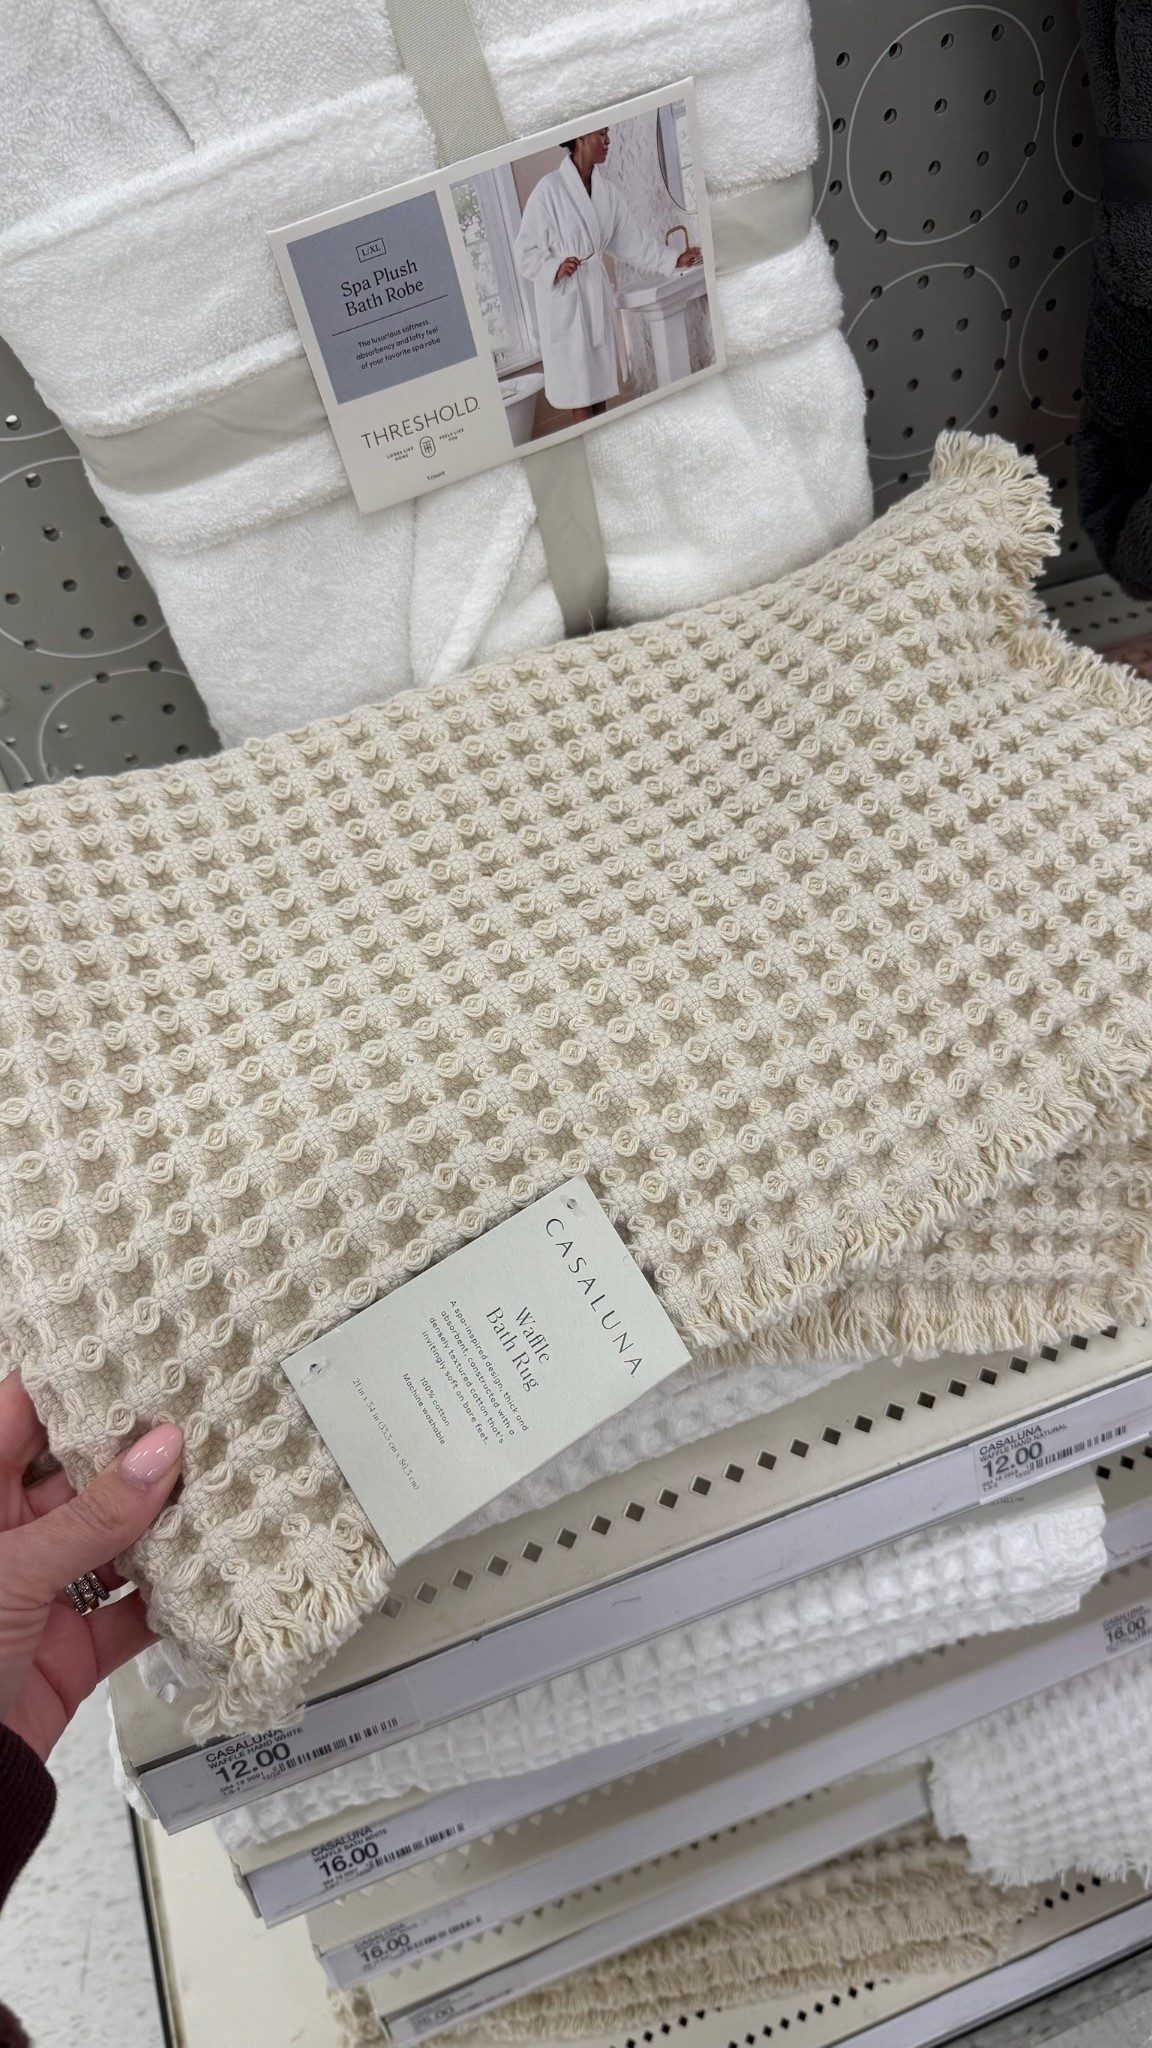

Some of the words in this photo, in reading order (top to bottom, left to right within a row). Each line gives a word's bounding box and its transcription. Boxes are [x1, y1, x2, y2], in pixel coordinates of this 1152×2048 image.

[361, 244, 381, 257] L/XL
[340, 279, 372, 298] Spa
[373, 259, 418, 286] Plush
[345, 293, 384, 317] Bath
[385, 280, 425, 303] Robe
[355, 343, 395, 361] absorbency
[396, 337, 409, 347] and
[409, 332, 425, 344] lofty
[425, 326, 439, 338] feel
[358, 340, 371, 349] The
[371, 330, 402, 345] luxurious
[360, 361, 369, 370] of
[369, 358, 384, 369] your
[384, 348, 412, 362] favorite
[411, 344, 425, 354] spa
[424, 337, 441, 349] robe
[486, 1306, 518, 1352] Bath
[511, 1351, 539, 1392] Rug
[515, 1306, 550, 1364] Waffle
[421, 1330, 447, 1370] invitingly
[444, 1370, 459, 1390] soft
[456, 1390, 464, 1402] on
[462, 1401, 477, 1423] bare
[475, 1423, 489, 1445] feet.
[429, 1317, 450, 1349] densely
[448, 1349, 473, 1388] textured
[470, 1388, 489, 1417] cotton
[486, 1417, 503, 1444] that's
[440, 1310, 469, 1357] absorbent,
[467, 1357, 501, 1408] constructed
[497, 1408, 513, 1429] with
[454, 1308, 488, 1360] spa-inspired
[485, 1361, 503, 1393] design,
[503, 1391, 518, 1414] thick
[516, 1415, 529, 1431] and
[402, 1373, 424, 1407] Machine
[422, 1407, 446, 1445] washable
[420, 1376, 434, 1399] 100%
[432, 1399, 450, 1427] cotton
[352, 1378, 362, 1387] 21
[358, 1388, 365, 1396] in
[372, 1413, 379, 1422] in
[388, 1441, 398, 1453] cm
[408, 1476, 420, 1490] cm)
[980, 1425, 1042, 1456] CASALUNA
[980, 1446, 1010, 1462] WAFFLE
[1010, 1437, 1032, 1450] HAND
[1033, 1423, 1068, 1440] NATURAL
[982, 1441, 1043, 1478] 12.00
[1105, 1616, 1146, 1643] 16.00
[205, 1729, 283, 1762] CASALUNA
[208, 1750, 246, 1769] WAFFLE
[247, 1740, 273, 1754] HAND
[274, 1727, 303, 1742] WHITE
[215, 1742, 291, 1783] 12.00
[311, 1825, 373, 1856] CASALUNA
[319, 1842, 379, 1877] 16.00
[361, 1933, 410, 1962] 16.00
